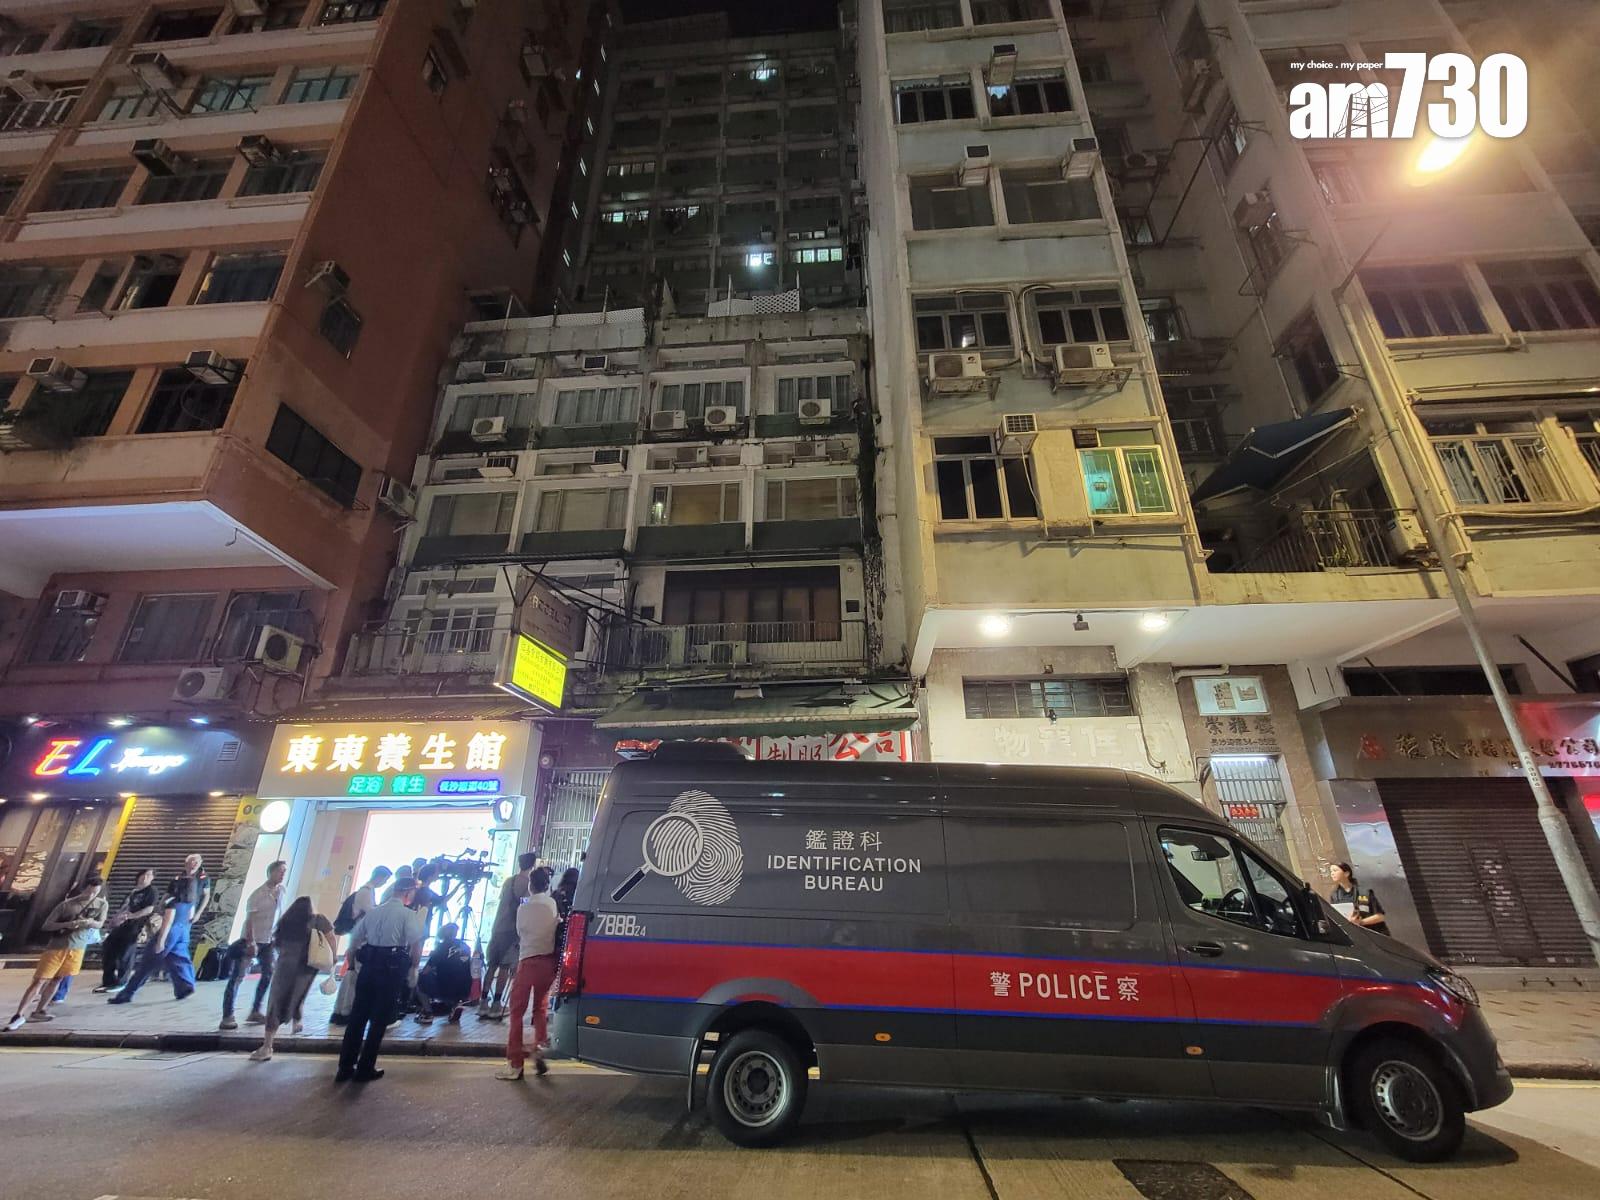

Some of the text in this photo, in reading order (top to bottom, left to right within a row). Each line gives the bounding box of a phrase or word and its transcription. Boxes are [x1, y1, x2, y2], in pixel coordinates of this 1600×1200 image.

[34, 738, 113, 777] EL
[281, 731, 508, 773] 東東養生館
[349, 775, 384, 794] 足浴
[805, 829, 883, 852] 鑑證科
[767, 855, 921, 873] IDENTIFICATION
[804, 875, 884, 892] BUREAU
[595, 914, 637, 936] 7888
[990, 971, 1140, 1002] 警 POLICE 察
